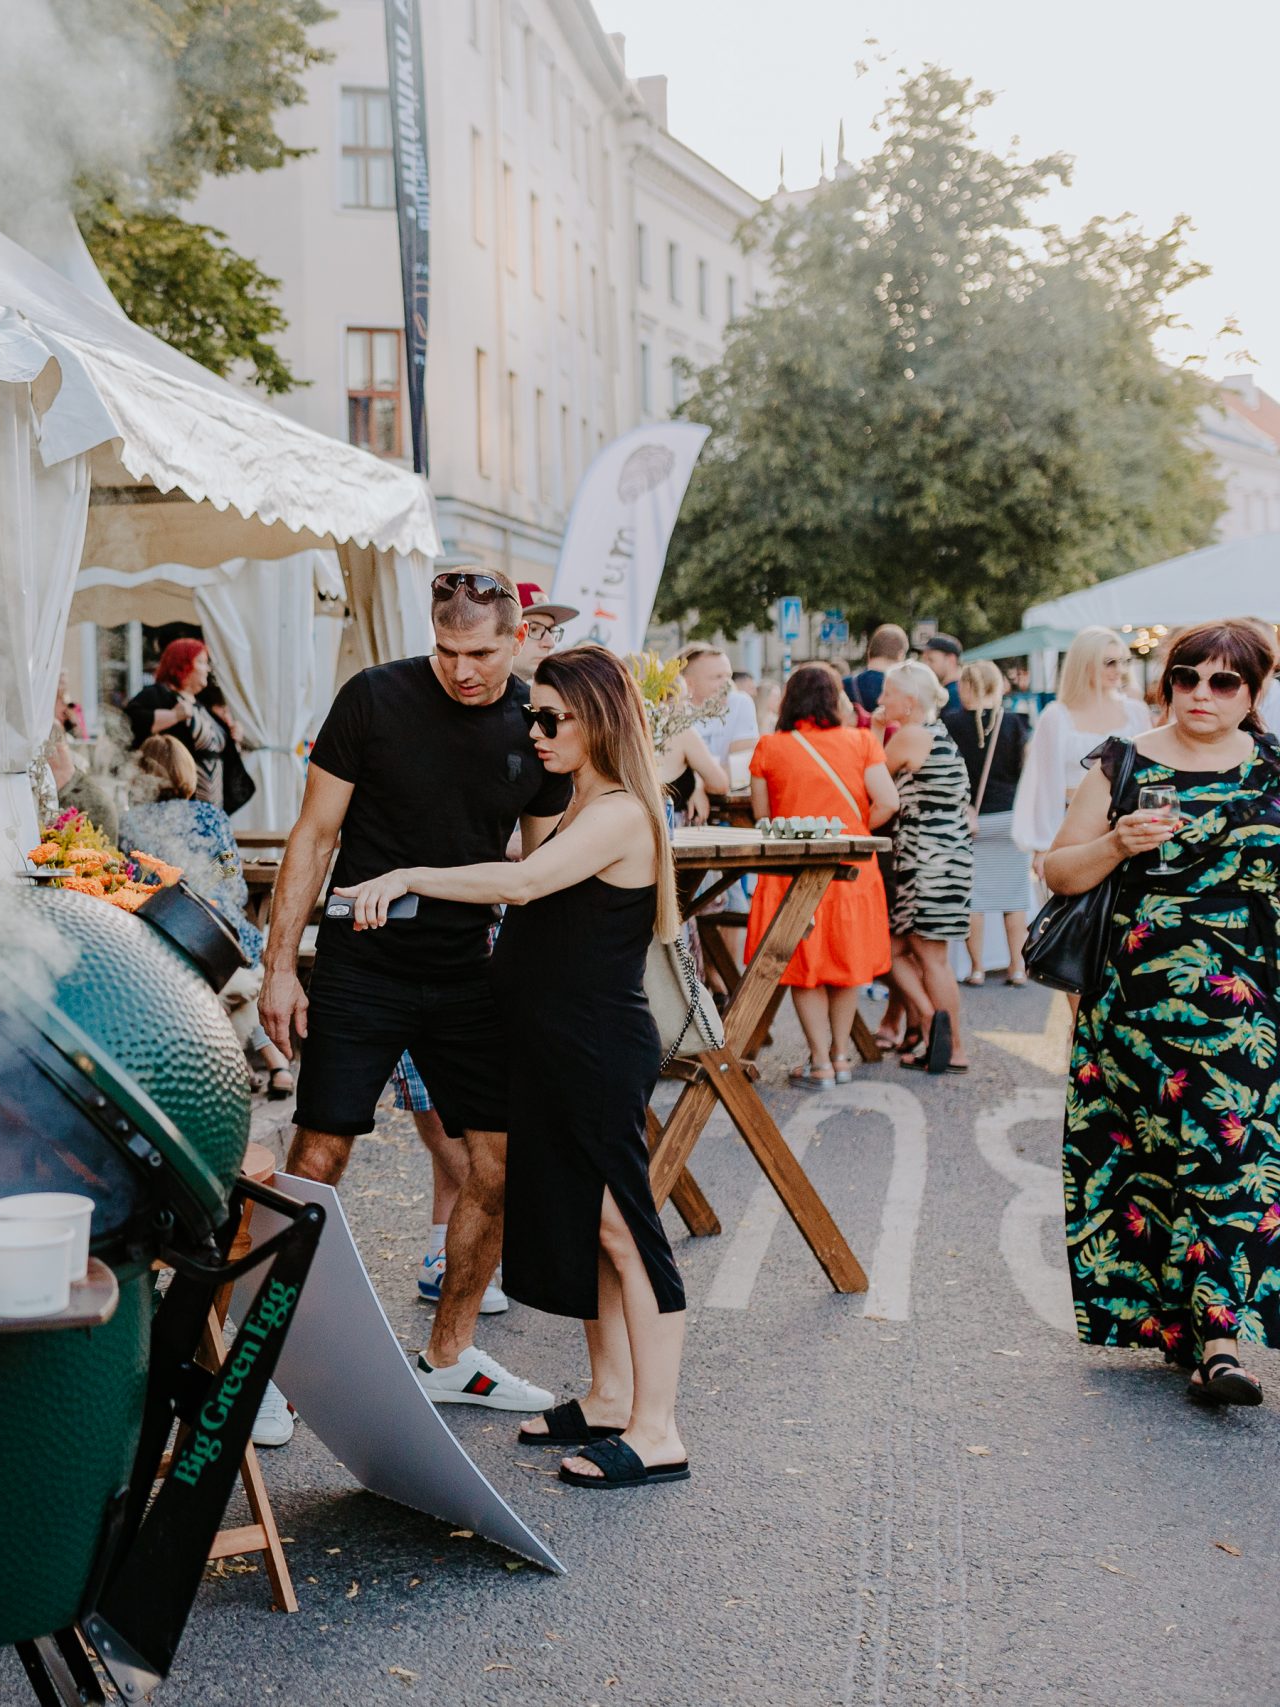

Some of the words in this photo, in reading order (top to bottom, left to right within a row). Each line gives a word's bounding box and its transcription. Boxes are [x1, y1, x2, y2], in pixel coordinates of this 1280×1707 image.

[174, 1430, 222, 1487] Big
[200, 1340, 262, 1431] Green
[244, 1278, 298, 1340] Egg
